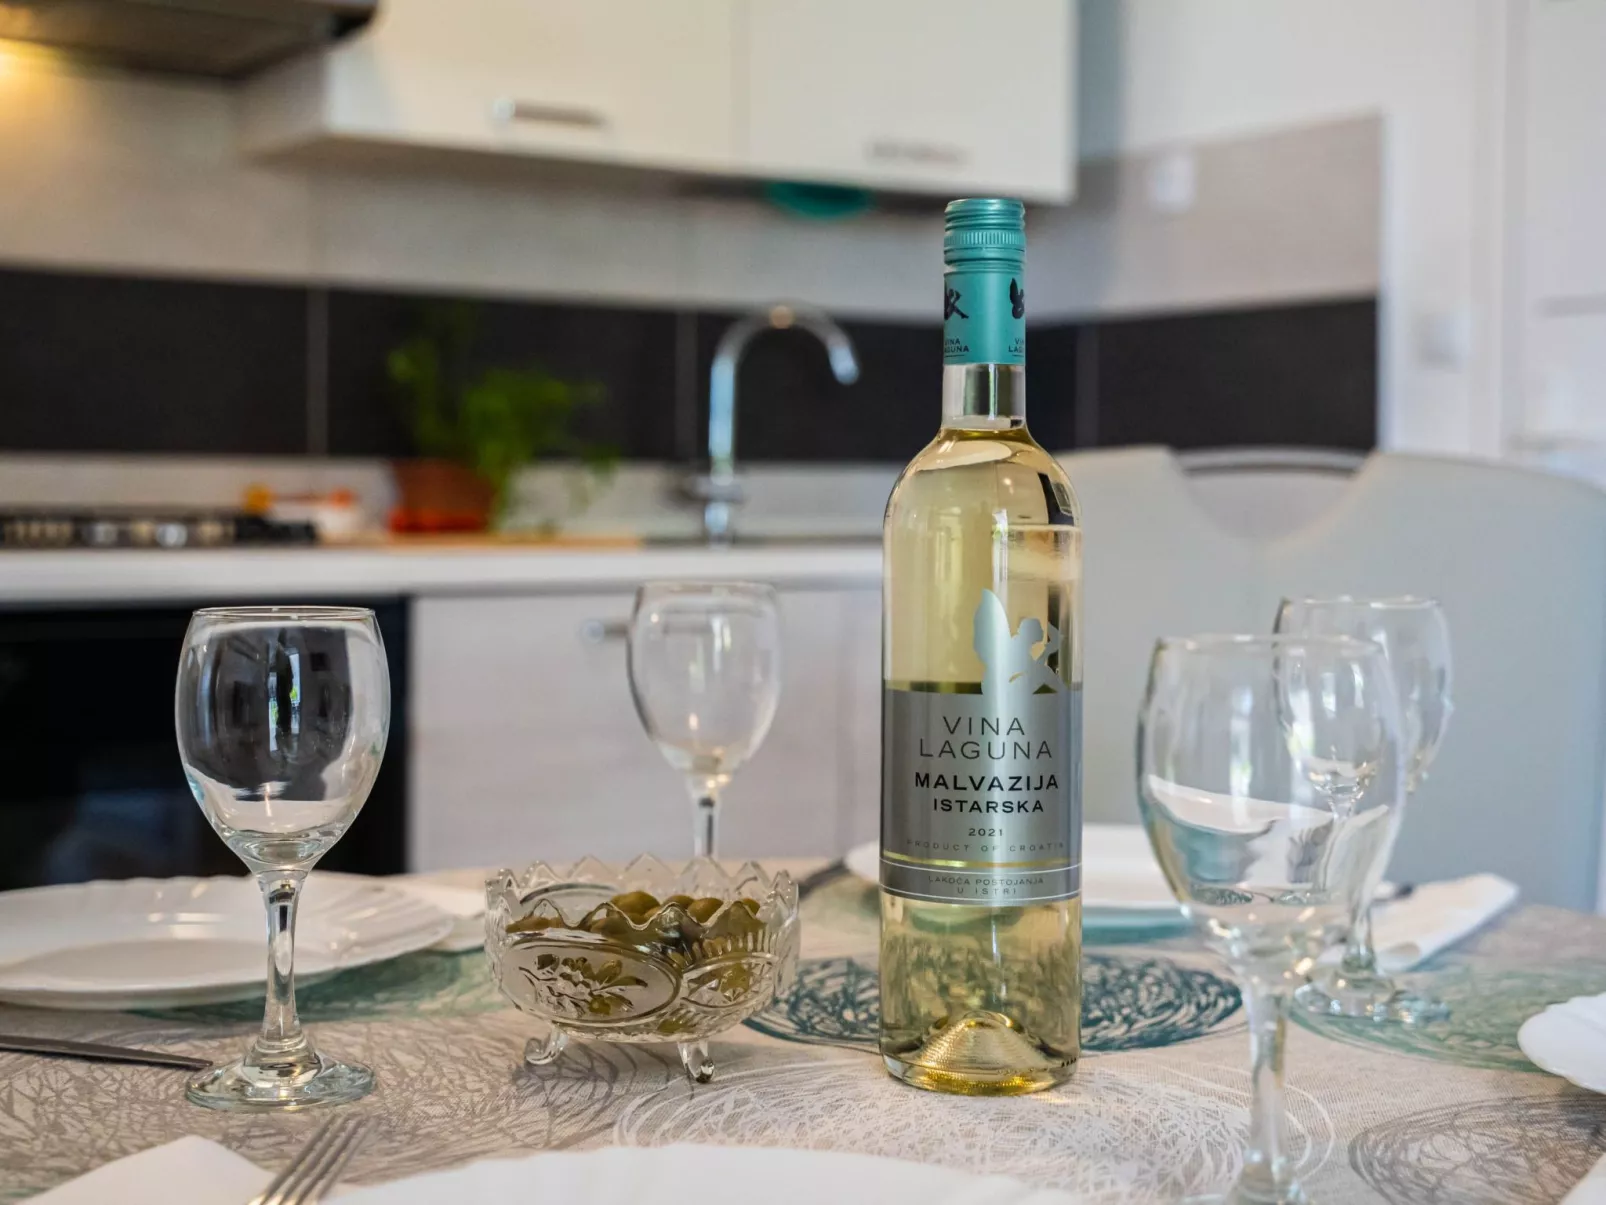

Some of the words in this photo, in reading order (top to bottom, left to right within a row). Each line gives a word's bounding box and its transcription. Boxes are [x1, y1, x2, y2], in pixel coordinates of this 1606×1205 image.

[942, 716, 1025, 736] VINA
[919, 738, 1053, 760] LAGUNA
[914, 772, 1059, 792] MALVAZIJA
[933, 798, 1044, 814] ISTARSKA
[968, 828, 1004, 837] 2021
[906, 838, 971, 852] PRODUCT
[980, 844, 1001, 852] OF
[1009, 842, 1064, 852] CROATIA
[975, 877, 1044, 886] POSTOJANJA
[957, 887, 964, 895] U
[975, 887, 1017, 895] ISTRI
